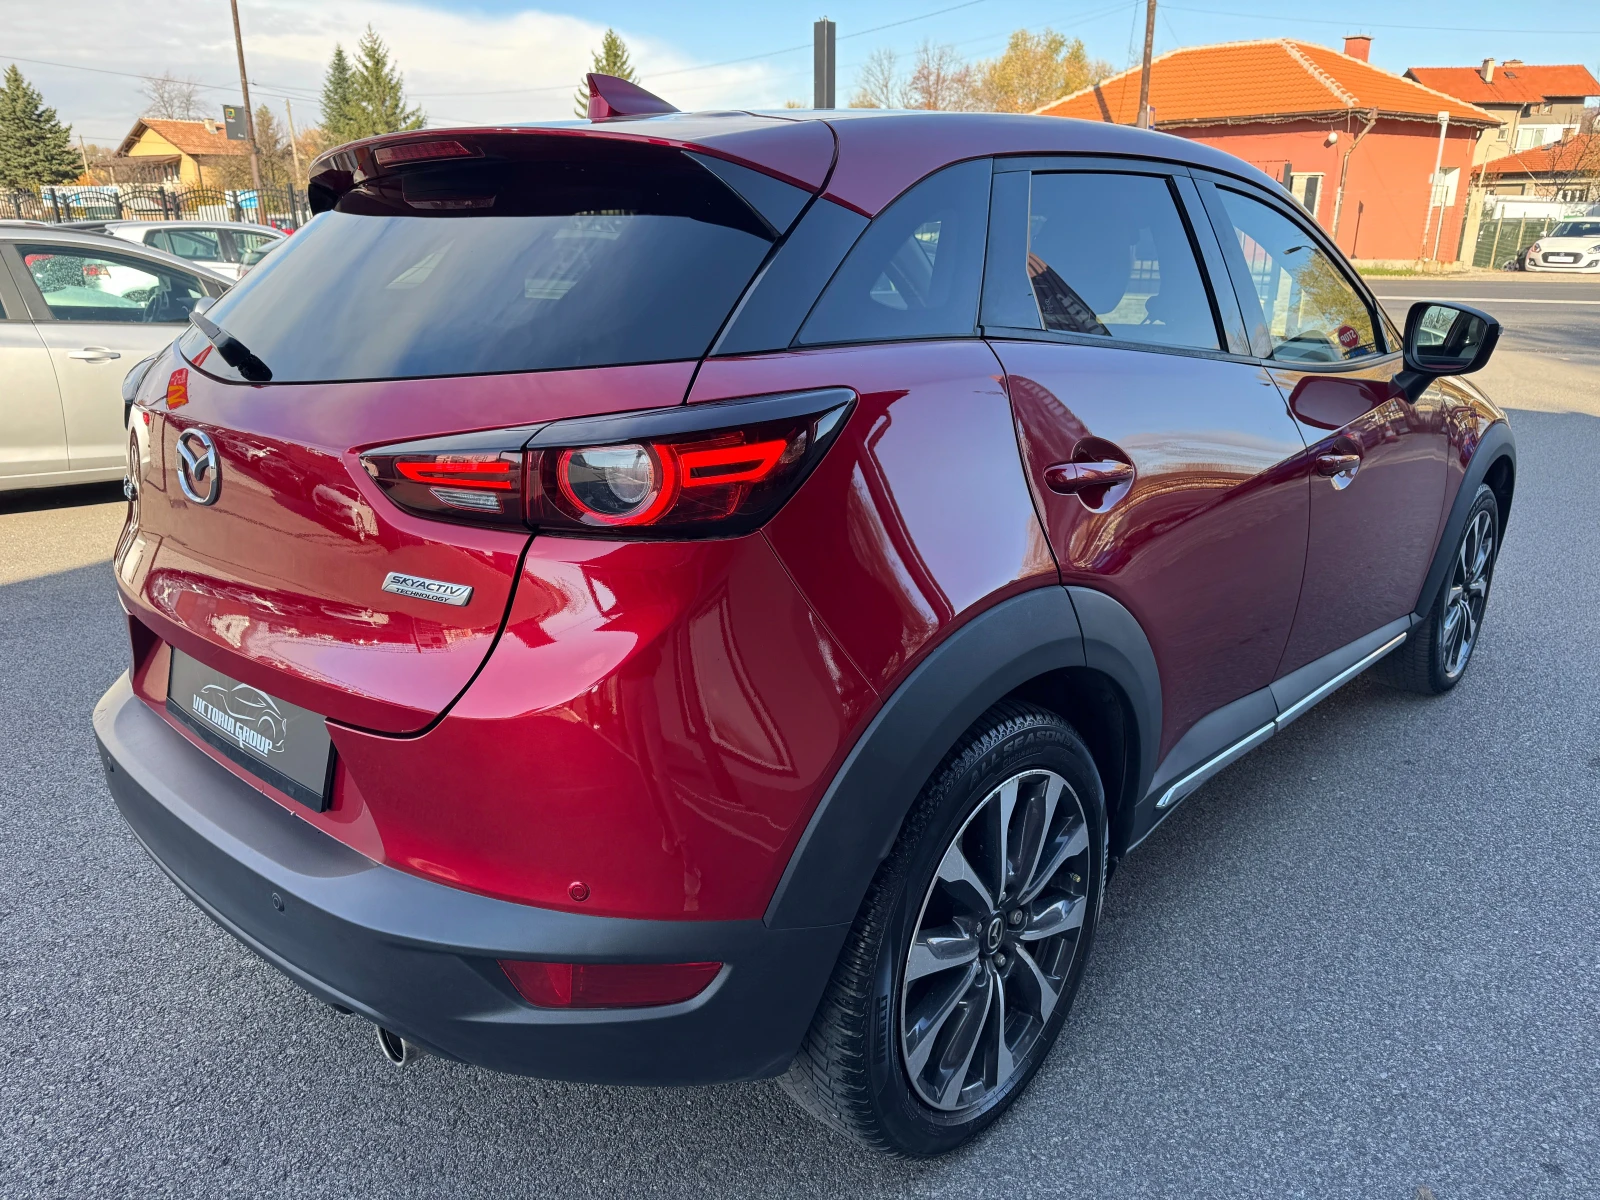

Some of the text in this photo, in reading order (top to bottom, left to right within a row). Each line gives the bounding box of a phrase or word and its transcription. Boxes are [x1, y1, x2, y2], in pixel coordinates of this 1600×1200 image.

[391, 575, 462, 595] SKYACTIV
[395, 587, 451, 603] TECHNOLOGY
[192, 693, 273, 755] VICTORIA GROUP
